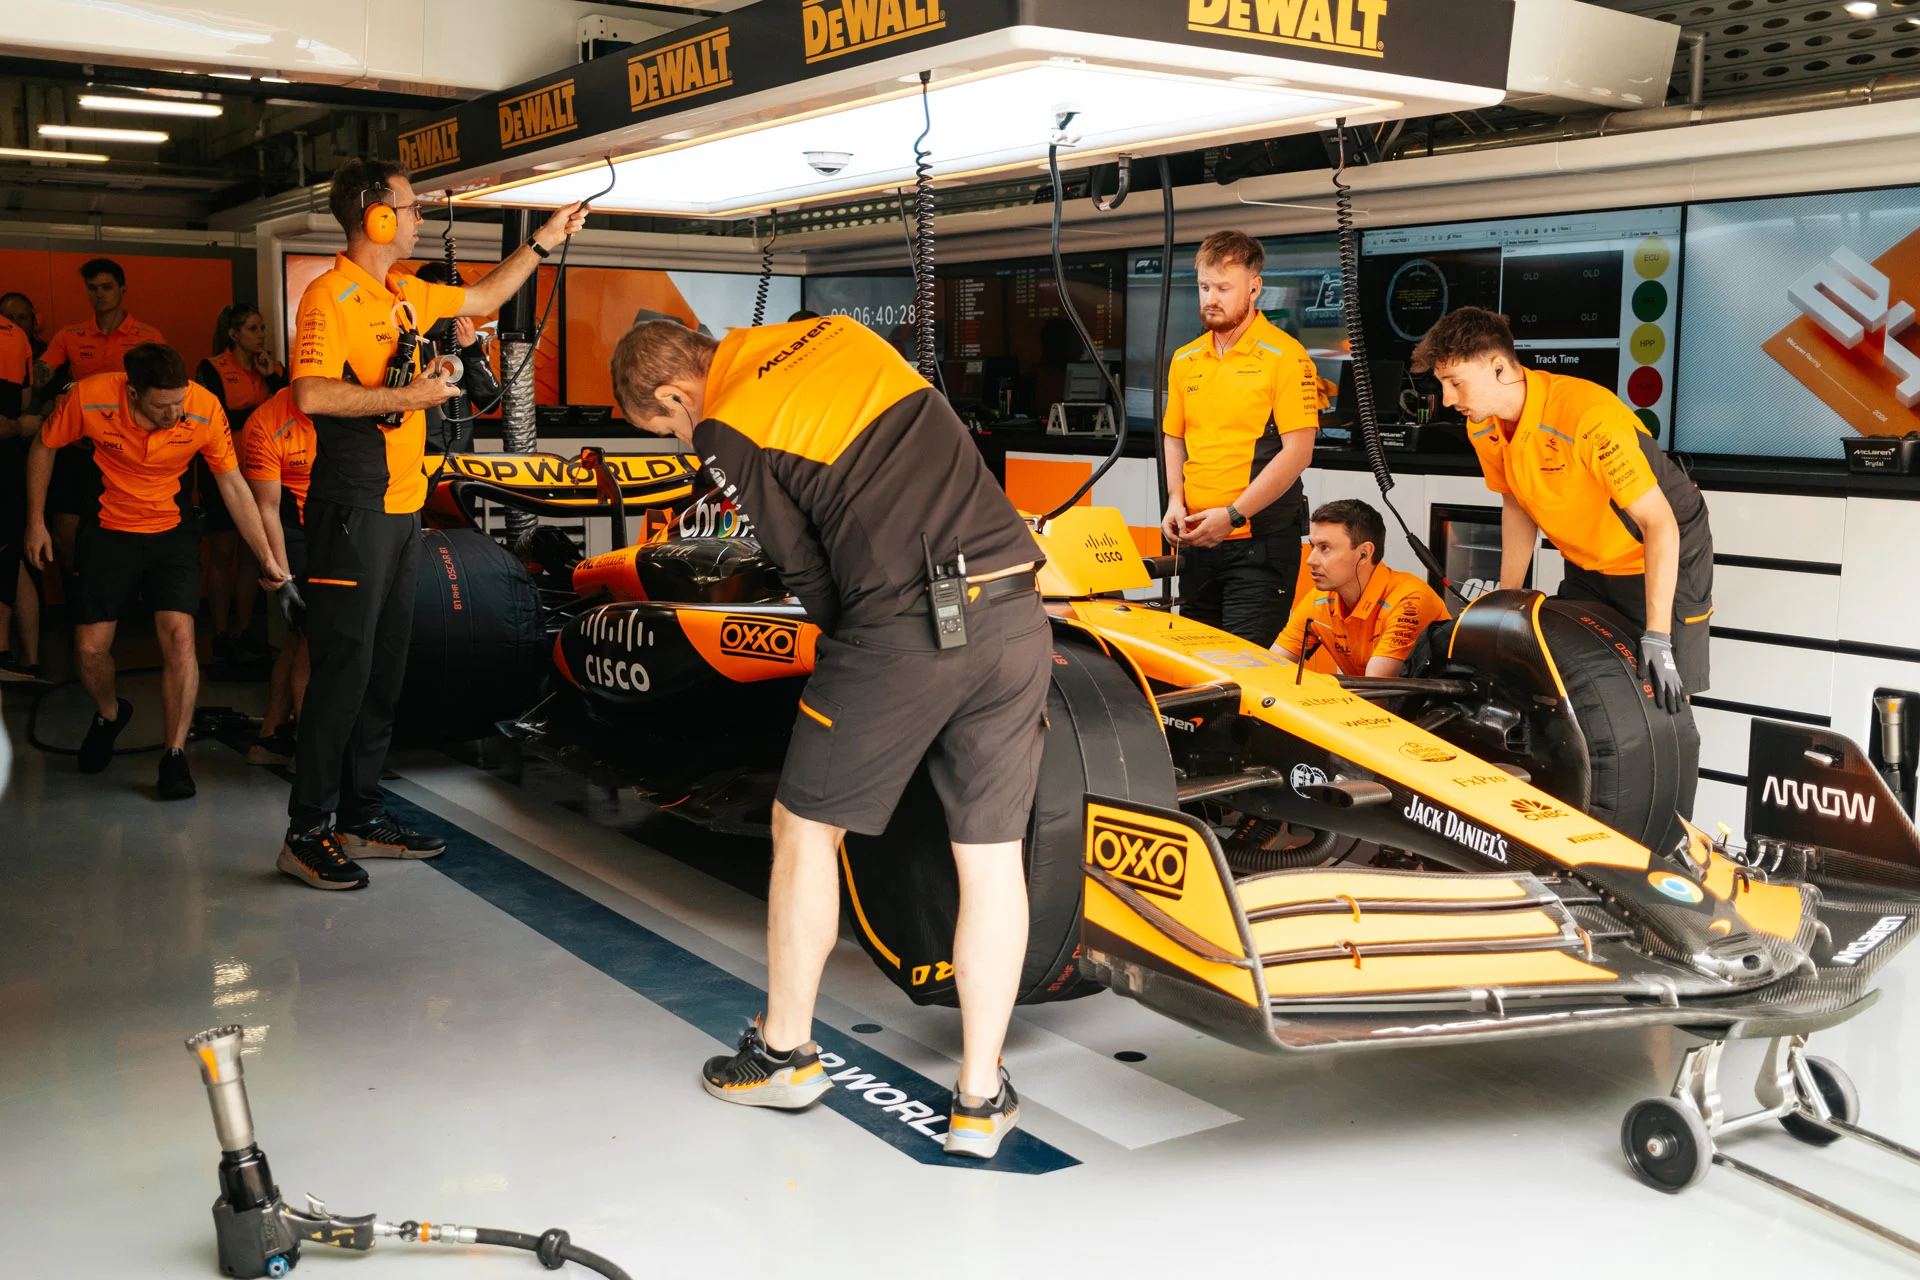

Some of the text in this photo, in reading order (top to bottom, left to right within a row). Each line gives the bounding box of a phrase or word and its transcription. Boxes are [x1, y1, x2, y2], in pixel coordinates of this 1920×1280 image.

[628, 38, 731, 102] DEWALT
[499, 84, 576, 144] DEWALT
[398, 121, 459, 169] DEWALT
[1643, 254, 1660, 262] ECU
[1523, 272, 1539, 280] OLD
[1583, 269, 1600, 278] OLD
[1521, 314, 1537, 323] OLD
[1580, 313, 1598, 321] OLD
[757, 320, 832, 380] McLaren
[1534, 354, 1580, 364] Track Time
[1853, 448, 1894, 456] McLaren
[461, 458, 518, 482] DP
[1095, 551, 1123, 564] CISCO
[722, 623, 794, 654] OXXO
[586, 654, 651, 692] CISCO
[1301, 696, 1354, 707] alteryx
[1161, 714, 1195, 733] aren
[1341, 716, 1393, 728] webex
[1452, 774, 1507, 787] FxPro
[1762, 775, 1876, 823] ARROW
[1523, 809, 1570, 821] CNBC
[1403, 794, 1508, 864] JACK DANIEL'S
[1094, 830, 1185, 885] OXXO
[830, 1066, 952, 1146] WORL
